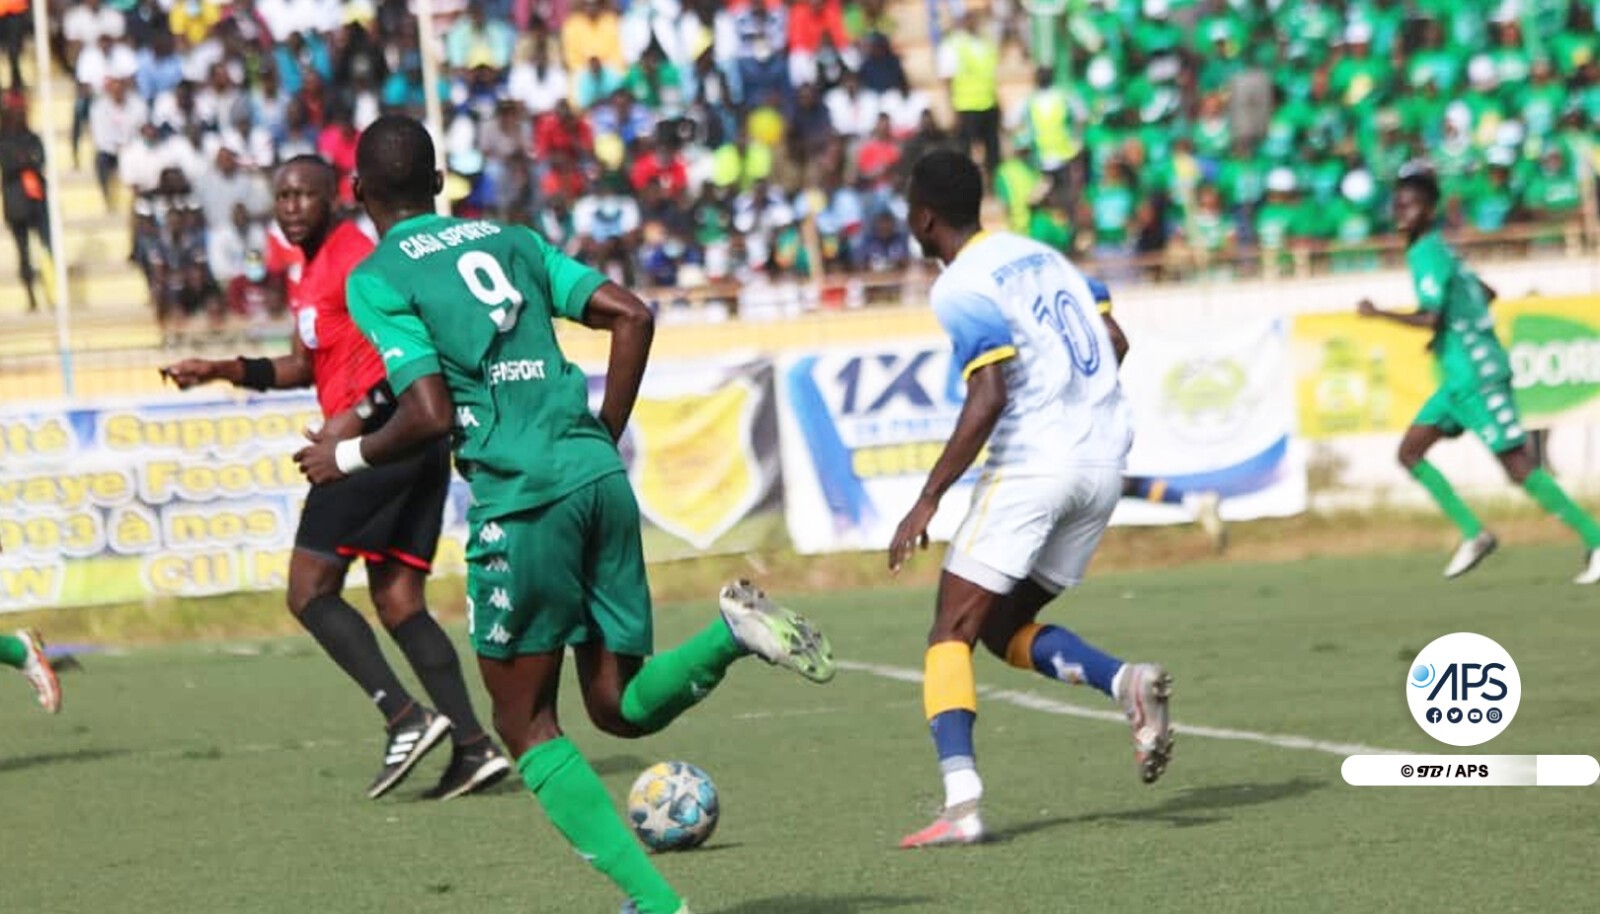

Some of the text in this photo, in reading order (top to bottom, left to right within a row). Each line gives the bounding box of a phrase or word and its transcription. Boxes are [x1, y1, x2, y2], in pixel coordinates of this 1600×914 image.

[437, 220, 501, 247] SPORTS
[457, 250, 523, 332] 9
[1032, 290, 1100, 377] 10
[171, 508, 277, 543] nos
